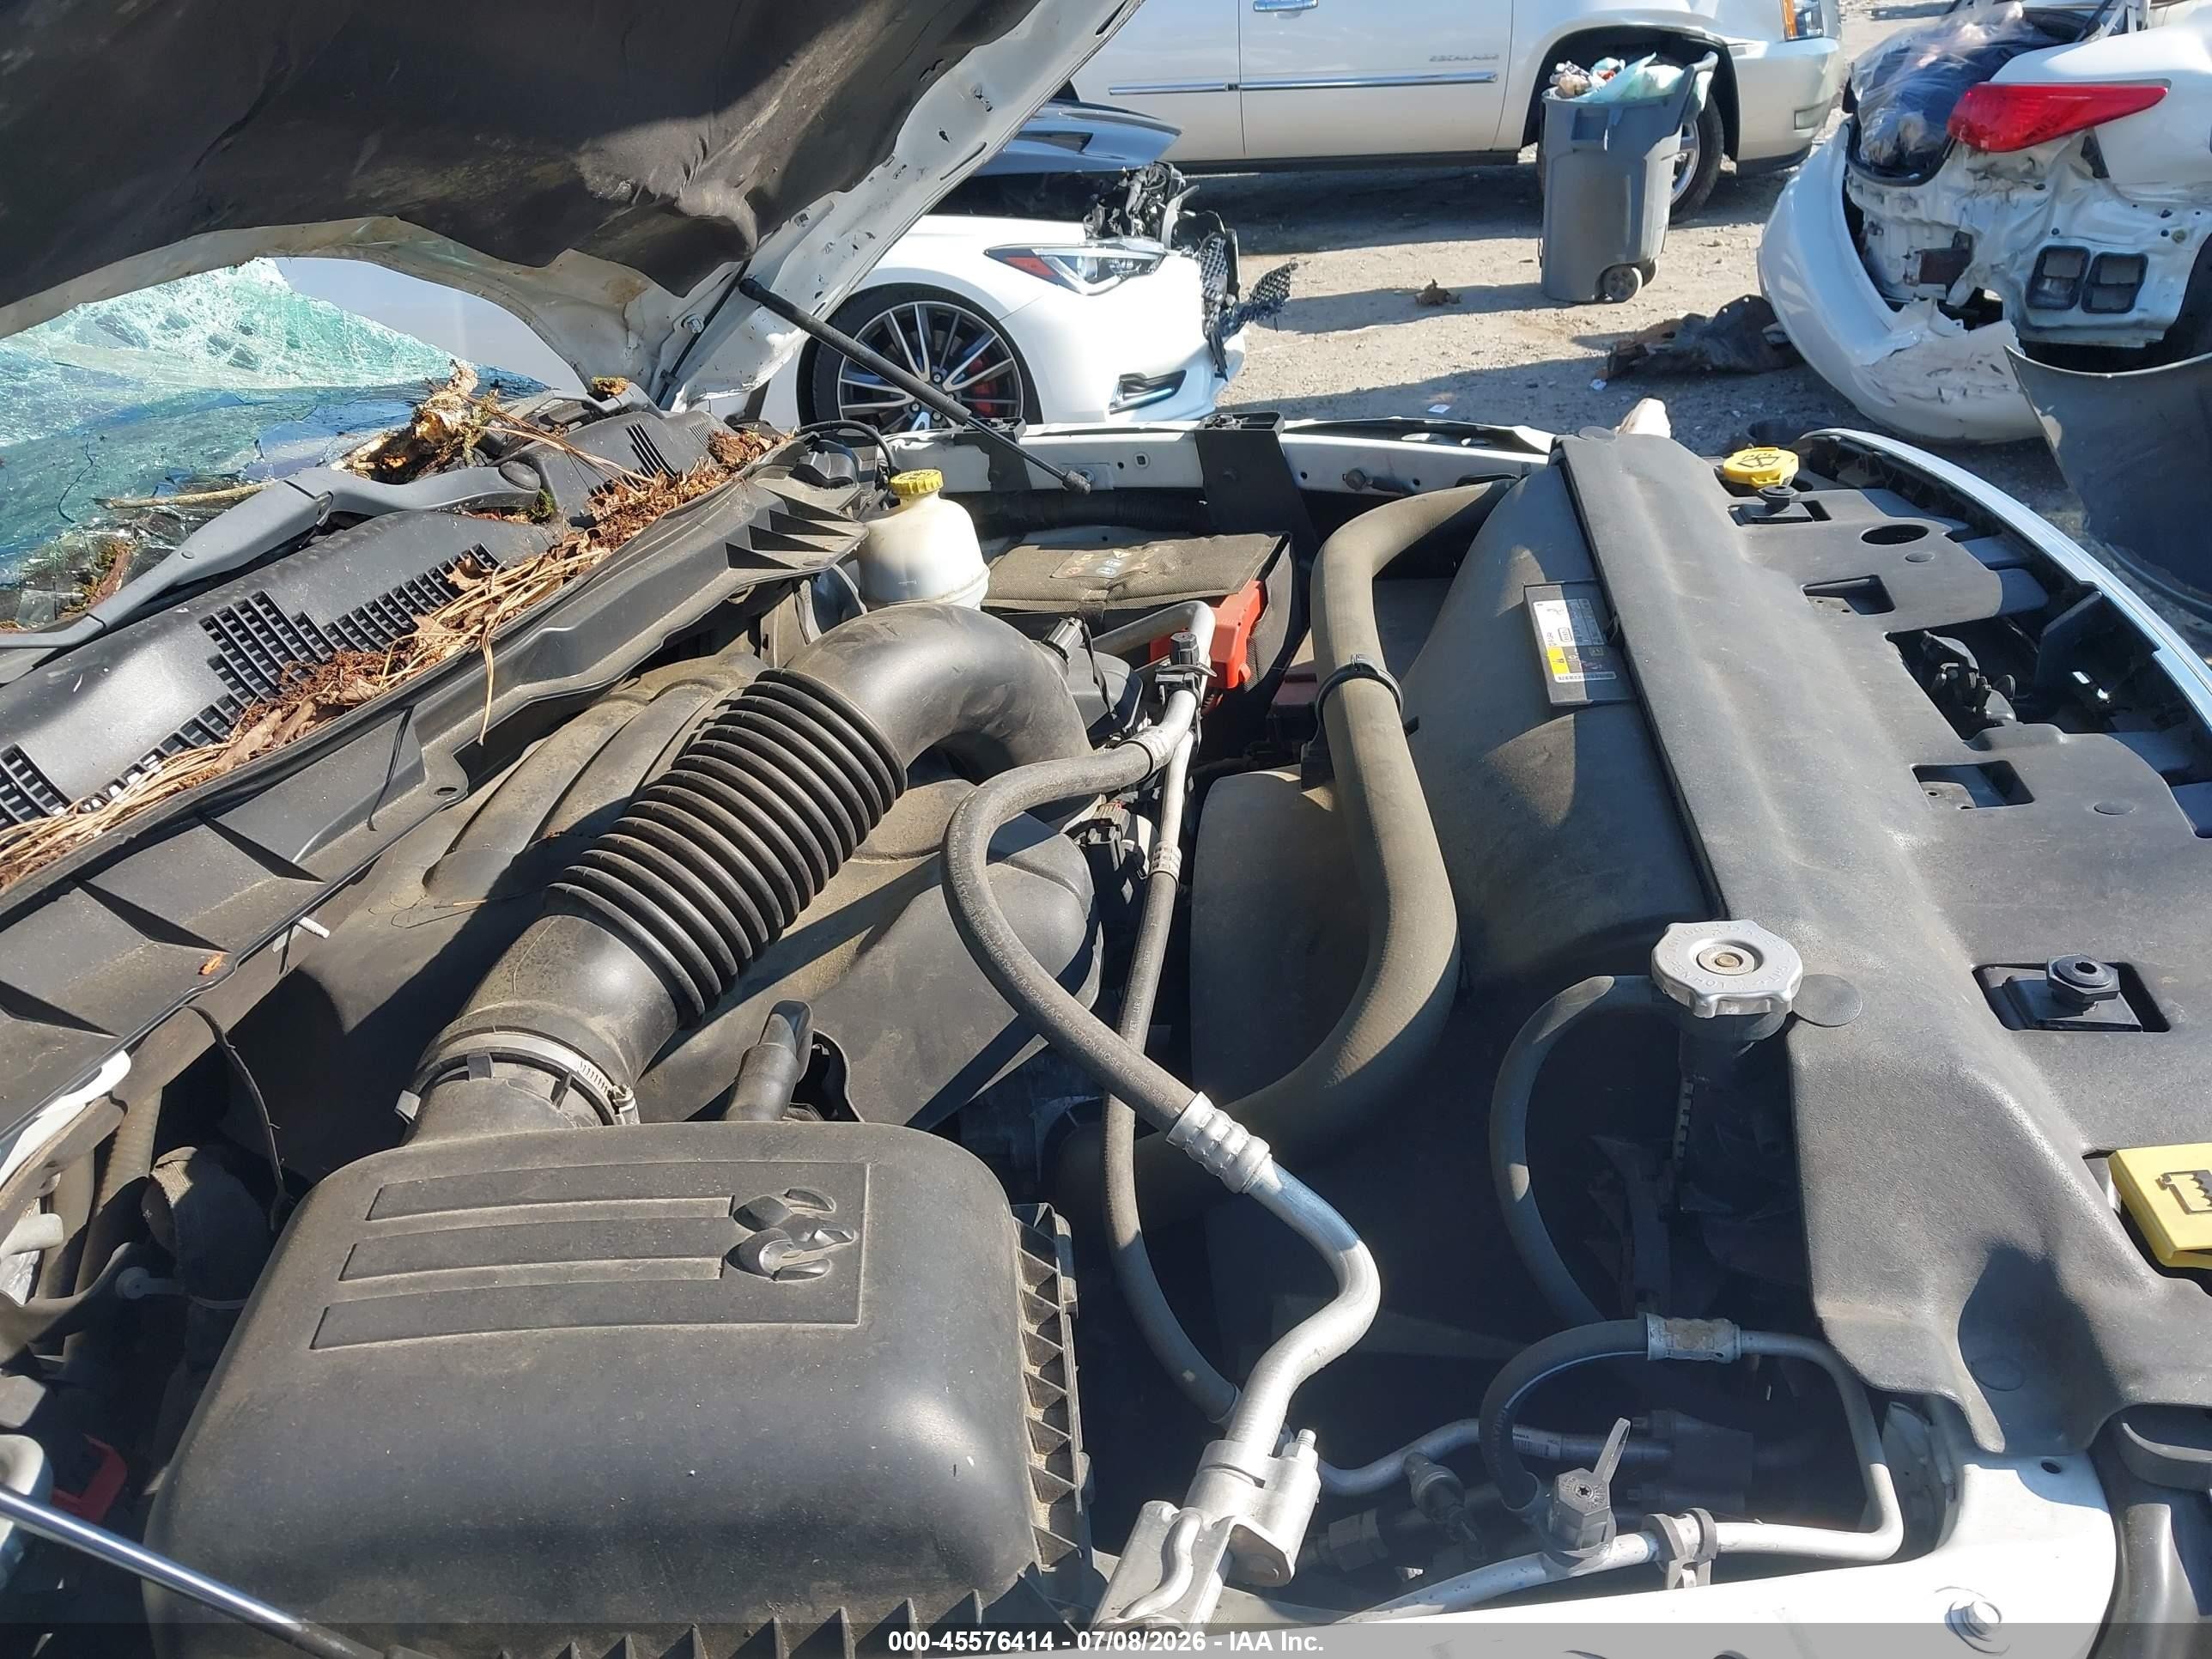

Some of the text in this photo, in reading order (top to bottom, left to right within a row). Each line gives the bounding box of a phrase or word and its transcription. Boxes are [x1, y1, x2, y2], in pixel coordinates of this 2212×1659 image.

[1429, 53, 1499, 63] ESCALADE
[949, 860, 969, 900] GALAXY
[1047, 1006, 1064, 1021] A/C
[1063, 1018, 1098, 1052] SUCTION
[1097, 1048, 1122, 1069] HOSE
